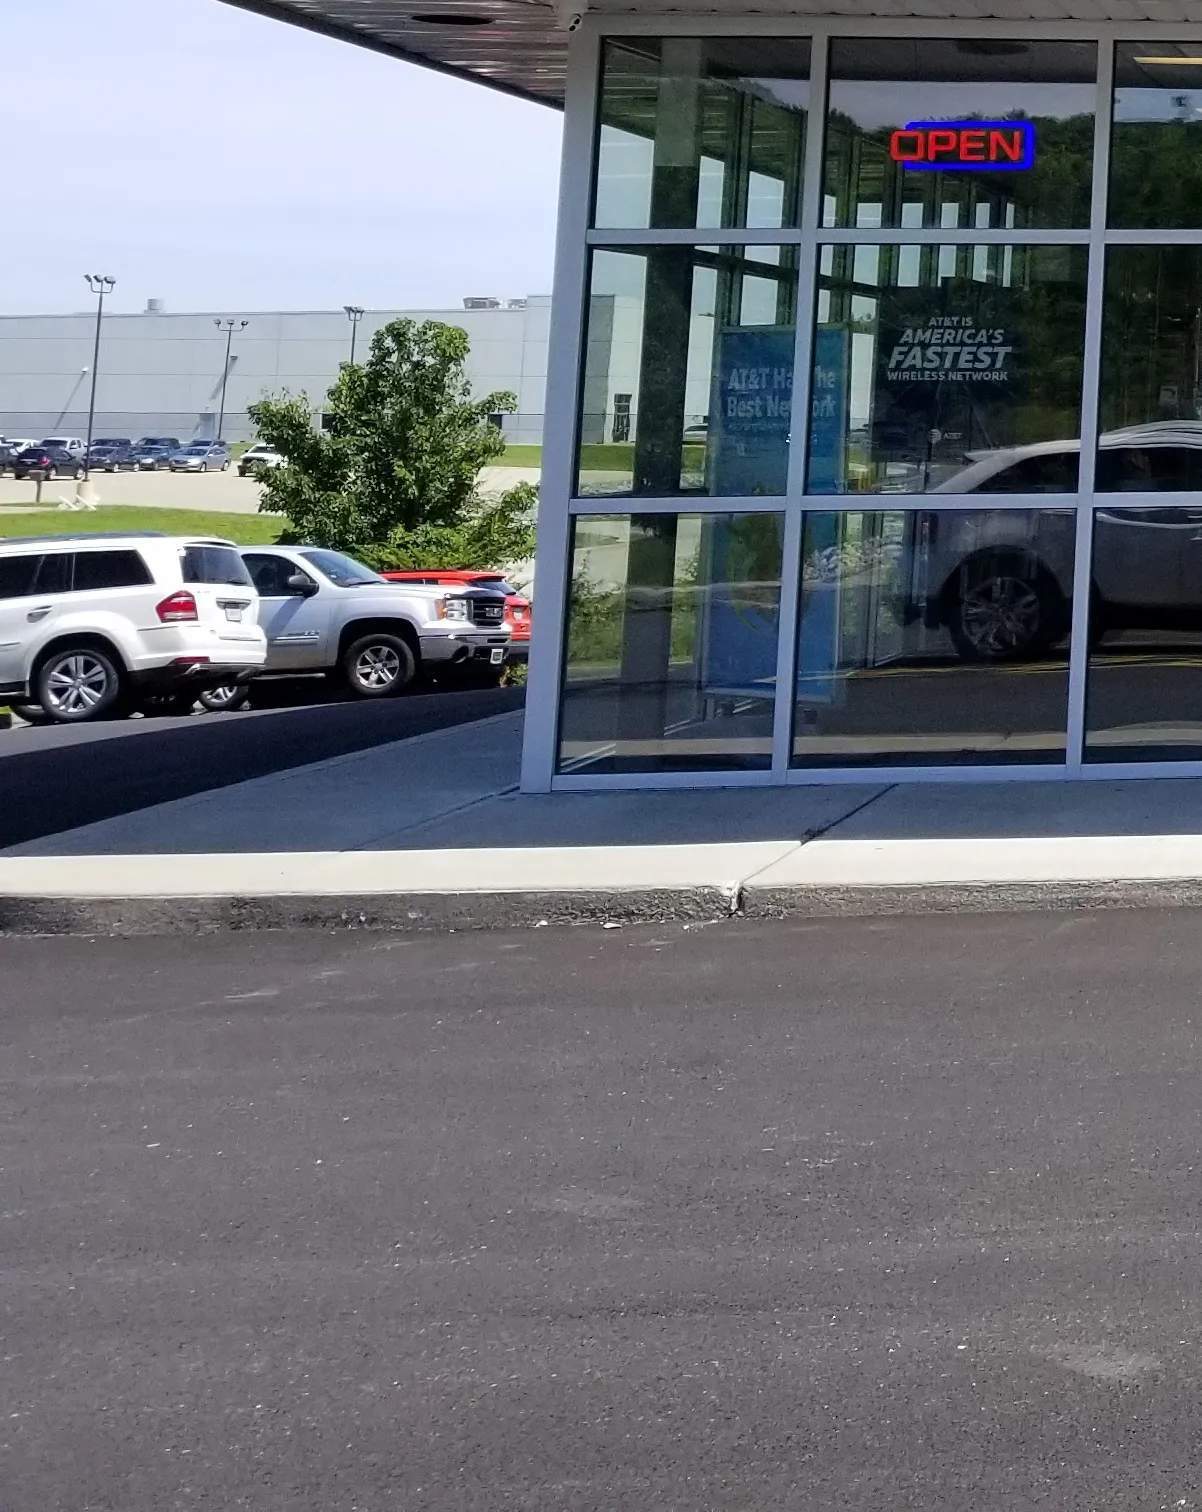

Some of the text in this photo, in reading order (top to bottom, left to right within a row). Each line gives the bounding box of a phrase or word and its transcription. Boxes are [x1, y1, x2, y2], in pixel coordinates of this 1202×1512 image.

[889, 129, 1022, 162] OPEN
[928, 316, 974, 327] AT&T IS
[899, 328, 1005, 344] AMERICA'S
[888, 346, 1013, 369] FASTEST
[727, 368, 770, 390] AT&T
[773, 368, 794, 389] Ha
[887, 370, 1009, 381] WIRELESS NETWORK
[727, 394, 836, 418] Best Neork
